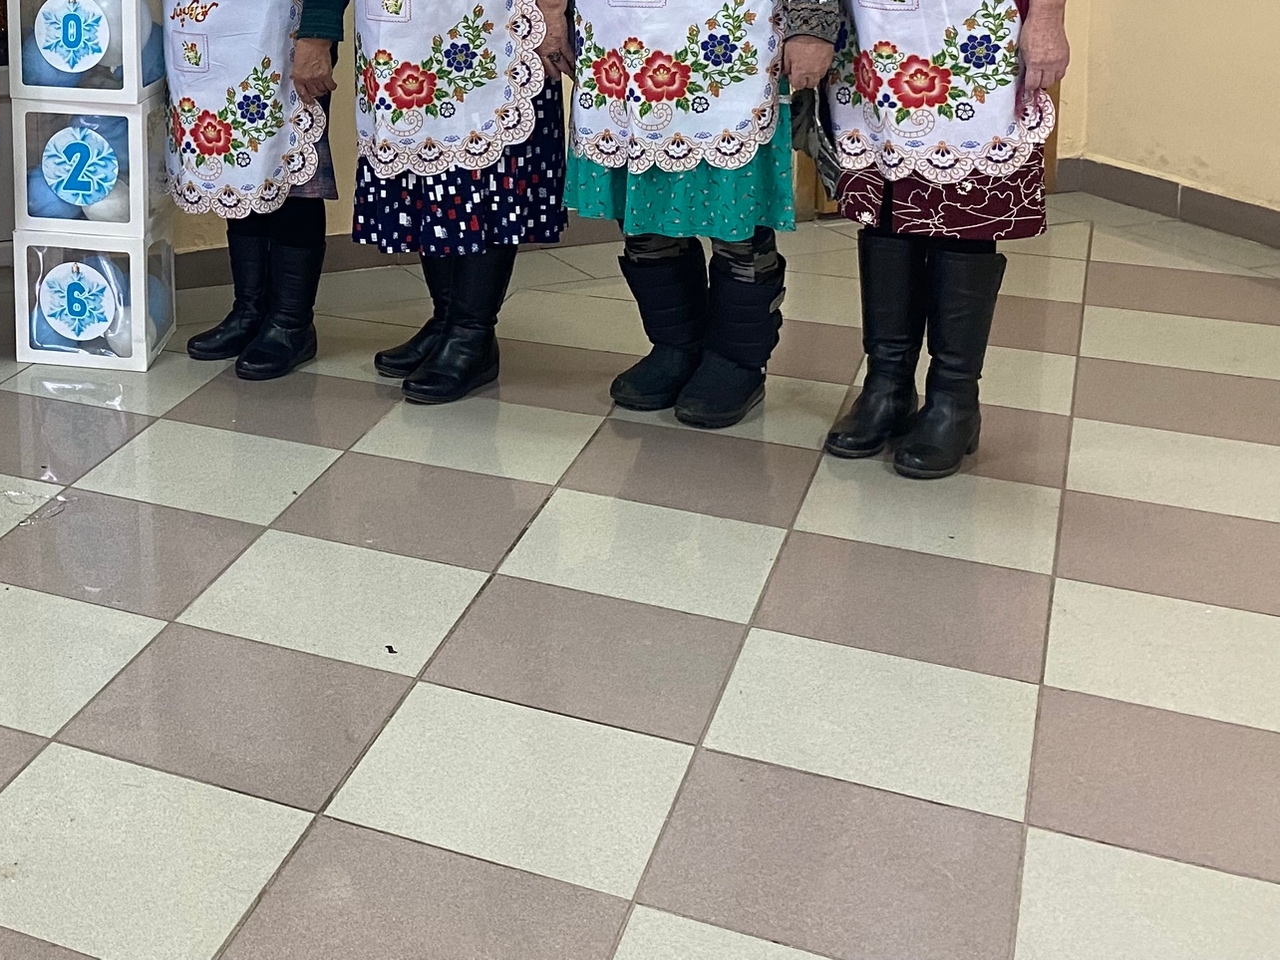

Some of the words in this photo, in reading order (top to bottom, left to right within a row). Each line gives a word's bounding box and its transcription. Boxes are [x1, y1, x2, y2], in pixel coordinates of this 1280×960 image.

[61, 12, 83, 50] 0
[62, 141, 92, 191] 2
[67, 281, 87, 318] 6
